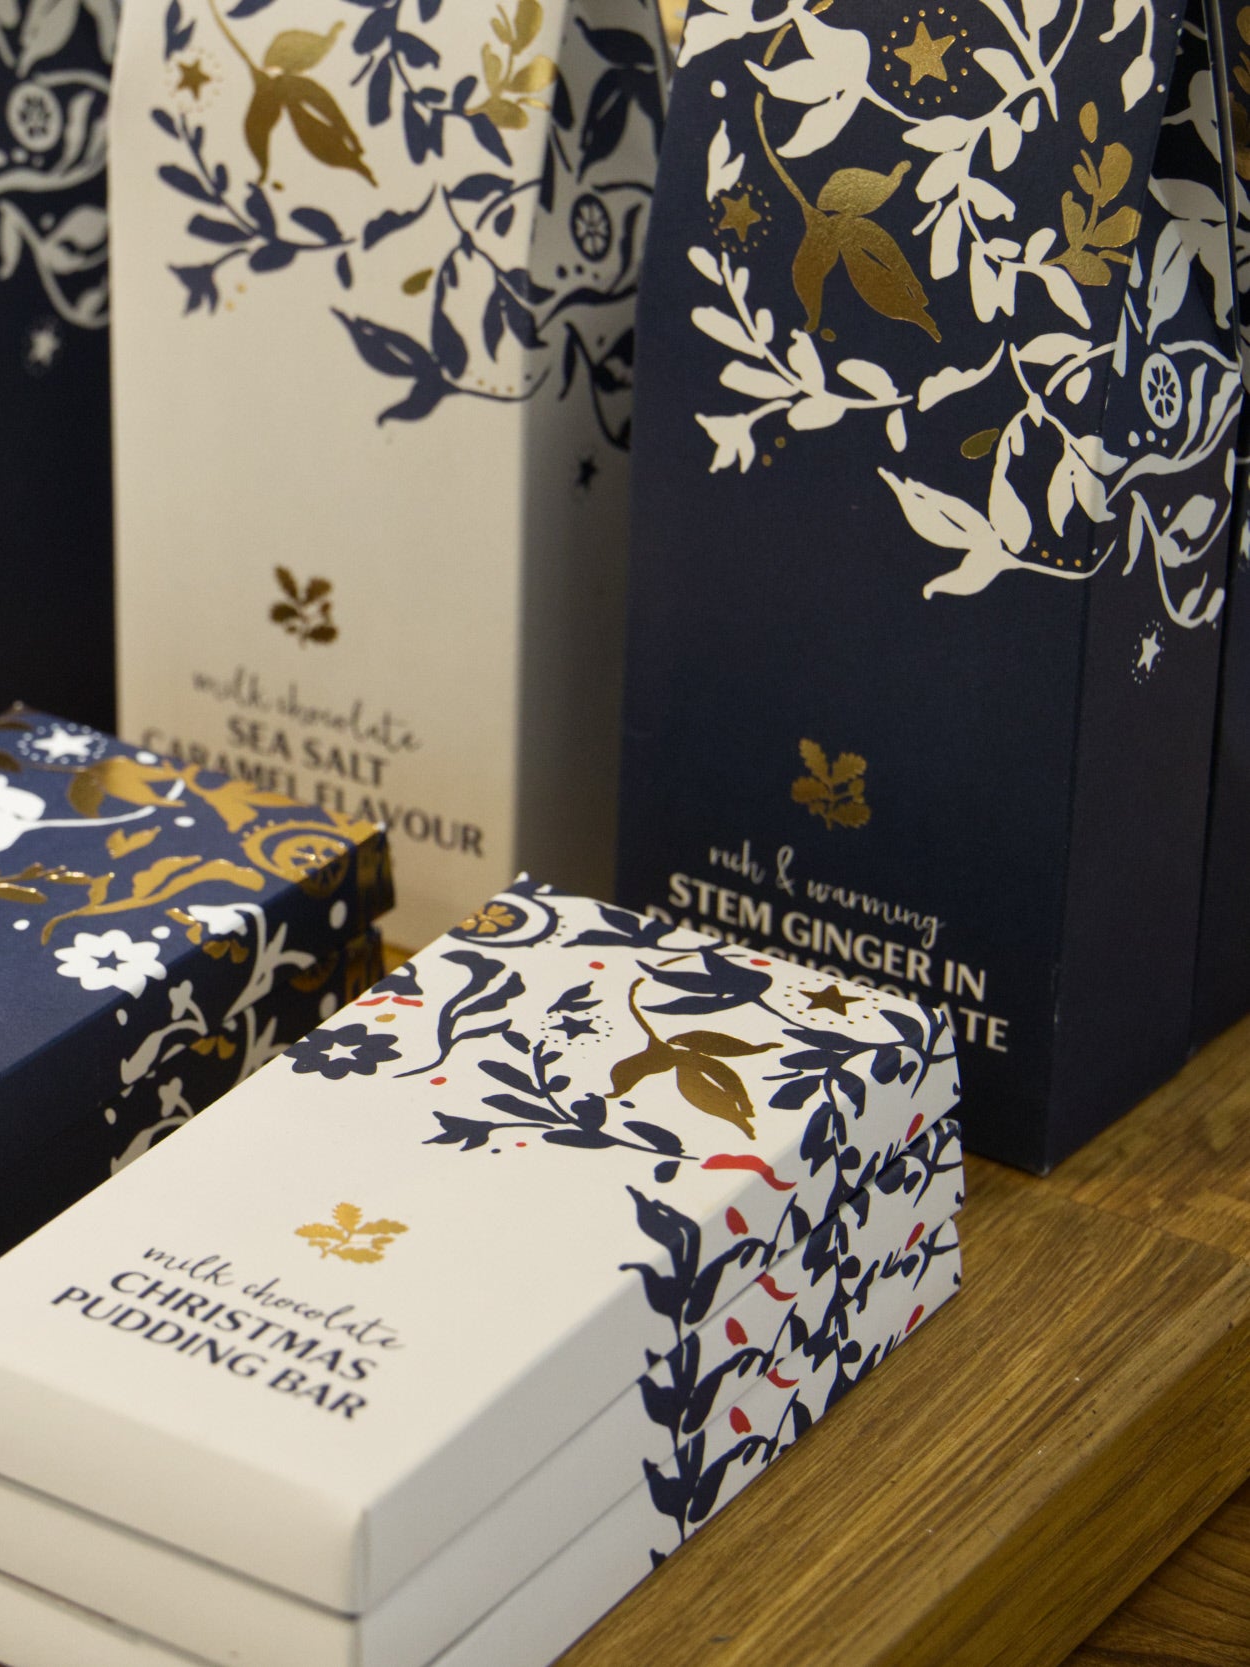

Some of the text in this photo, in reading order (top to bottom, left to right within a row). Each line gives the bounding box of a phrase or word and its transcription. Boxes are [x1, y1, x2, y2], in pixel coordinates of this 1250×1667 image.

[193, 665, 423, 752] milk chocolate
[227, 715, 389, 789] SEA SALT
[315, 780, 485, 858] FLAVOUR
[669, 872, 773, 936] STEM
[781, 911, 932, 988] GINGER
[942, 959, 987, 1002] IN
[709, 840, 766, 885] rich
[776, 845, 795, 897] &
[806, 877, 946, 950] warming
[110, 1270, 378, 1381] CHRISTMAS
[142, 1246, 406, 1350] milk chocolate
[50, 1285, 368, 1420] PUDDING BAR
